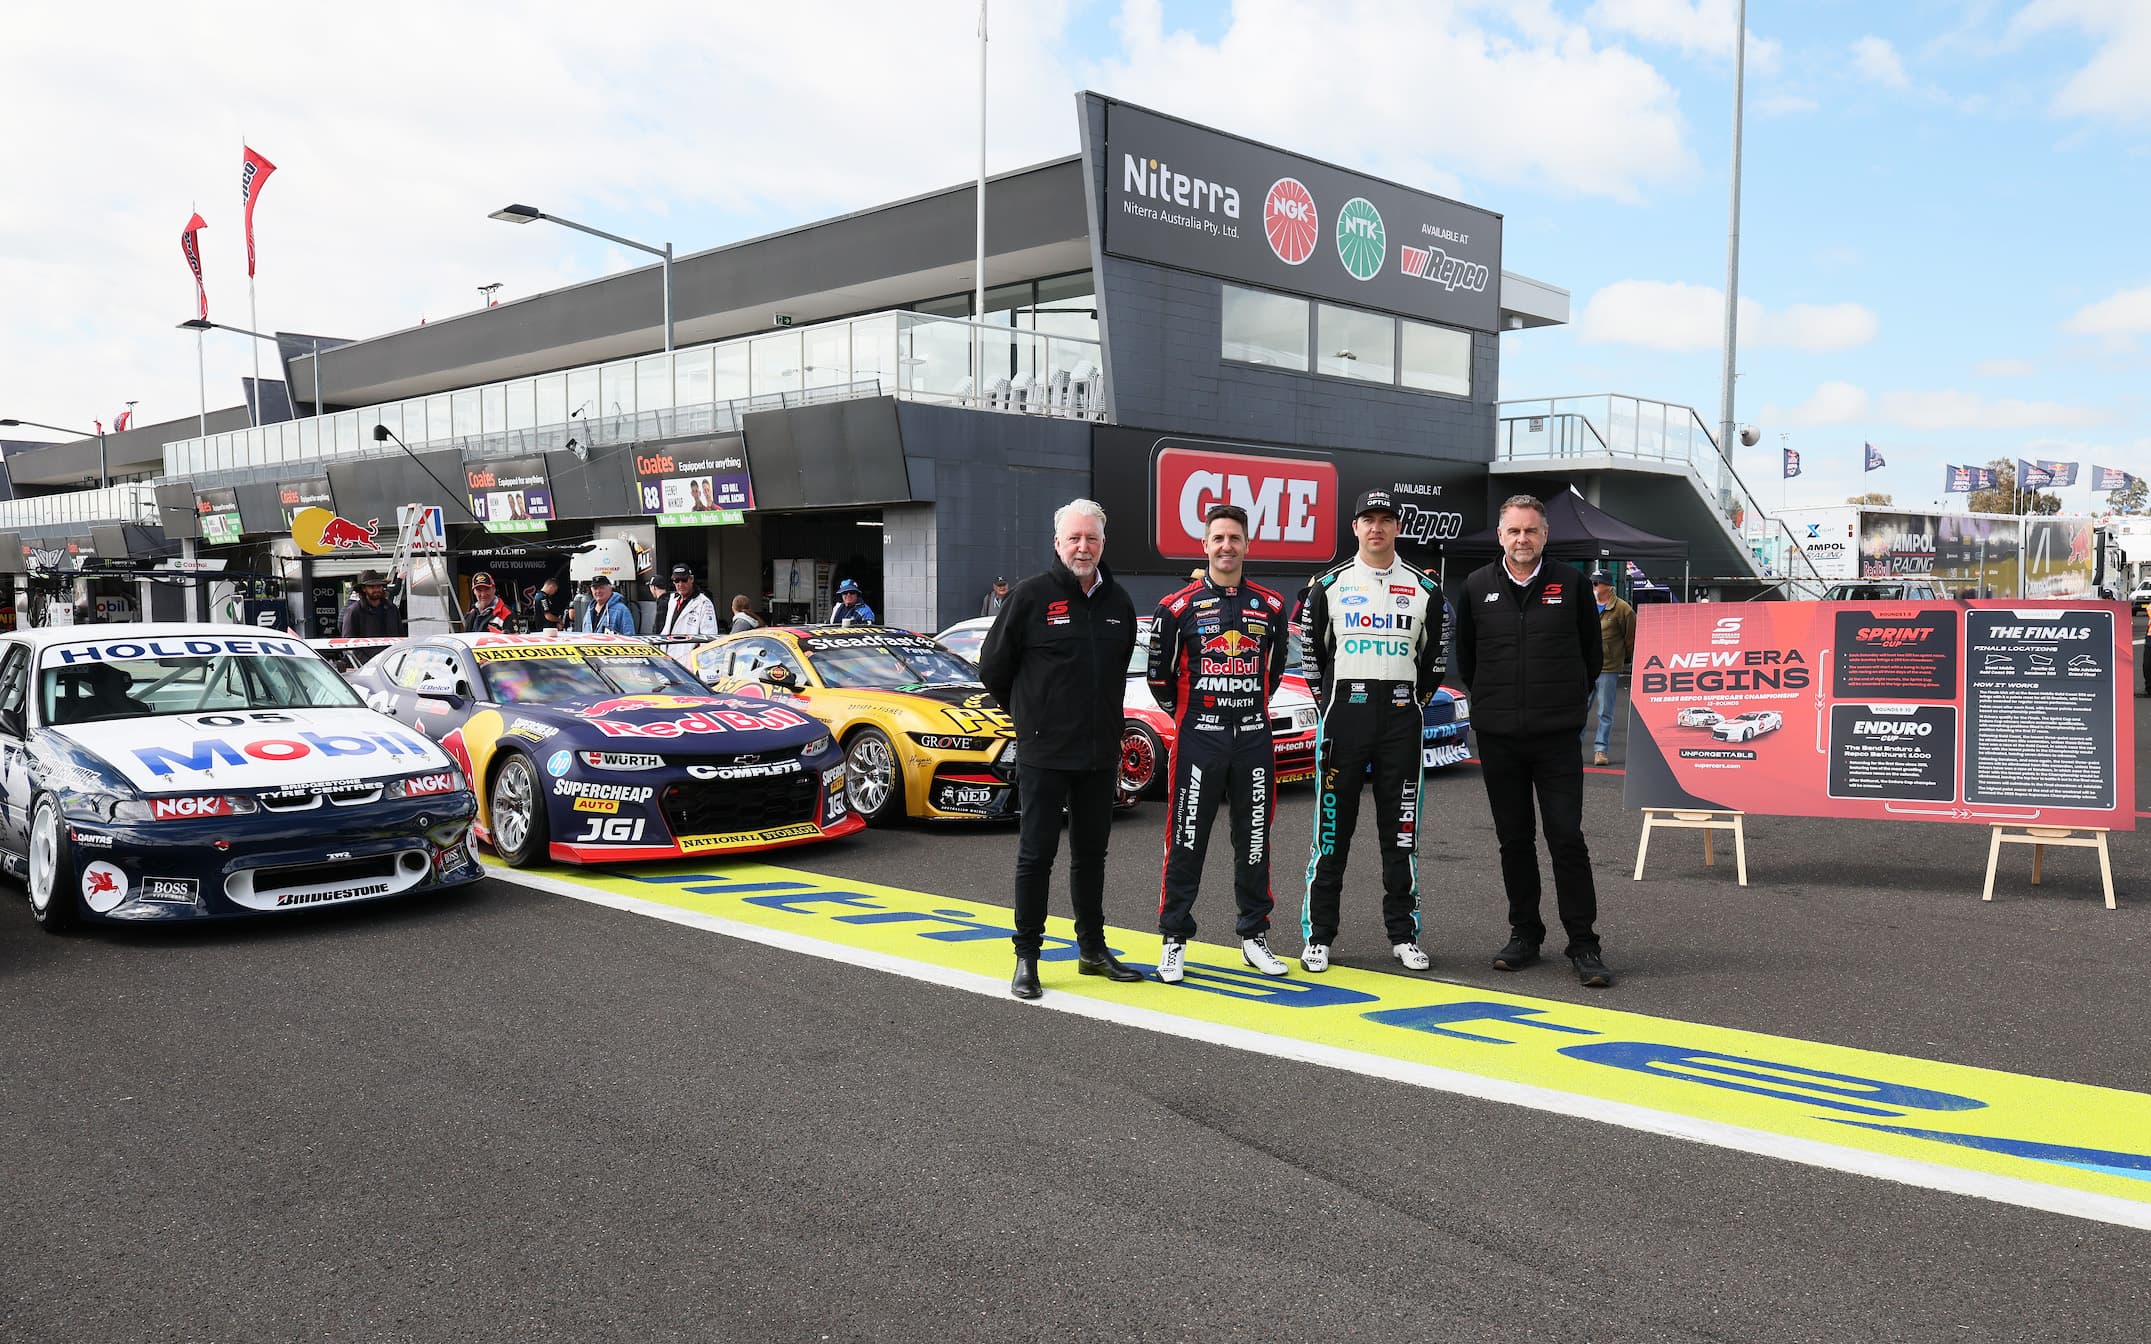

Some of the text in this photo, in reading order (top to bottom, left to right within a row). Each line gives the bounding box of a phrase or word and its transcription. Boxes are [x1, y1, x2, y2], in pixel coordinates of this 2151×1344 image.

[1124, 153, 1240, 219] Niterra
[1123, 200, 1240, 239] Niterra Australia Pty. Ltd.
[1273, 196, 1309, 224] NGK
[1344, 215, 1377, 242] NTK
[1421, 223, 1470, 245] AVAILABLE AT
[1424, 246, 1490, 292] Repco
[637, 454, 675, 475] Coates
[678, 458, 742, 472] Equipped for anything
[469, 471, 497, 489] Coates
[1393, 483, 1442, 496] AVAILABLE AT
[474, 498, 486, 518] 87
[643, 486, 660, 510] 88
[1179, 469, 1319, 544] GME
[1400, 504, 1462, 545] Repco
[1806, 543, 1846, 551] AMPOL
[1893, 534, 1937, 553] AMPOL
[490, 561, 546, 569] GIVES YOU WINGS
[1863, 560, 1891, 577] Red Bull
[1892, 557, 1935, 573] RACING
[1345, 612, 1393, 629] Mobil
[807, 635, 918, 650] Steadfast
[1856, 627, 1934, 641] SPRINT
[1990, 626, 2091, 640] THE FINALS
[61, 640, 296, 664] HOLDEN
[475, 645, 655, 662] NATIONAL STORAGE
[1345, 640, 1409, 656] OPTUS
[1200, 656, 1260, 675] Red Bull
[1643, 649, 1805, 669] A NEW ERA
[1194, 677, 1261, 693] AMPOL
[1642, 668, 1810, 693] BEGINS
[196, 713, 296, 727] 05
[510, 717, 559, 738] SUPERCHEAP
[584, 707, 810, 739] Red Bull
[1853, 721, 1932, 736] ENDURO
[921, 735, 971, 749] GROVE
[1274, 741, 1304, 752] Hi-tech
[132, 730, 428, 776] Mobil
[1681, 750, 1754, 760] UNFORGETTABLE
[552, 753, 569, 774] hp
[686, 762, 802, 780] COMPLETE
[256, 781, 384, 800] TYRE CENTRES
[280, 778, 362, 791] BRIDGESTONE
[410, 773, 450, 794] NGK
[554, 779, 653, 803] SUPERCHEAP
[579, 800, 614, 811] AUTO
[957, 790, 991, 803] NED
[1179, 787, 1187, 823] Premium
[156, 797, 215, 818] NGK
[1183, 777, 1201, 851] AMPLIFY
[1248, 767, 1266, 865] GIVES YOU WINGS
[577, 818, 646, 842] JGI
[1321, 793, 1337, 856] OPTUS
[1396, 801, 1416, 848] Mobil
[78, 834, 113, 845] QANTAS
[683, 825, 817, 848] NATIONAL STORAGE
[153, 881, 188, 895] BOSS
[276, 883, 390, 907] BRIDGESTONE
